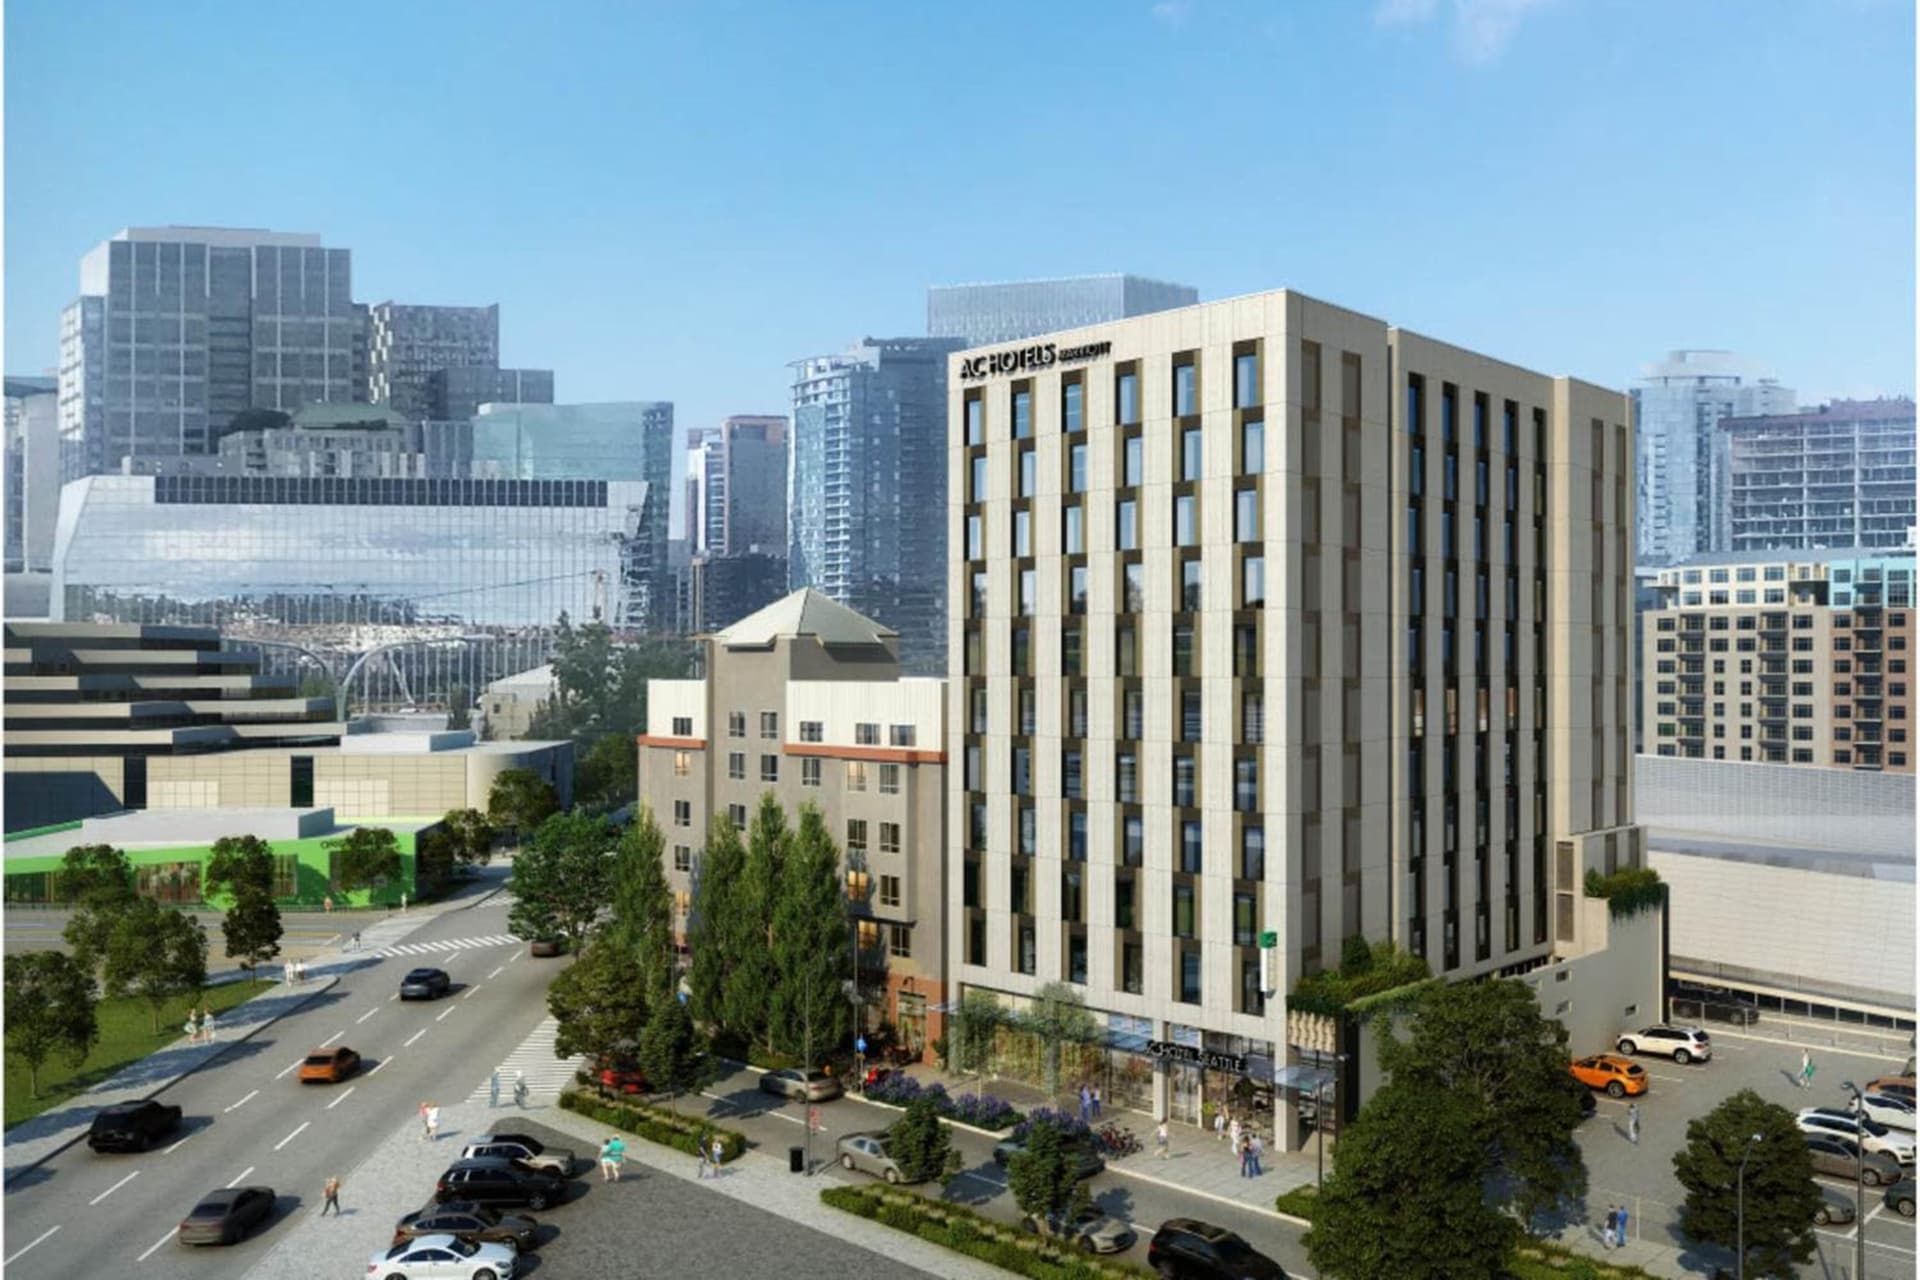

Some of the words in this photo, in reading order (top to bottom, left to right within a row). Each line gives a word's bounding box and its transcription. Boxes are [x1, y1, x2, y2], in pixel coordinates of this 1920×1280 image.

[960, 356, 987, 379] AC
[989, 343, 1057, 374] HOTELS
[1160, 1044, 1195, 1061] HOTEL
[1199, 1052, 1241, 1073] SEATTLE
